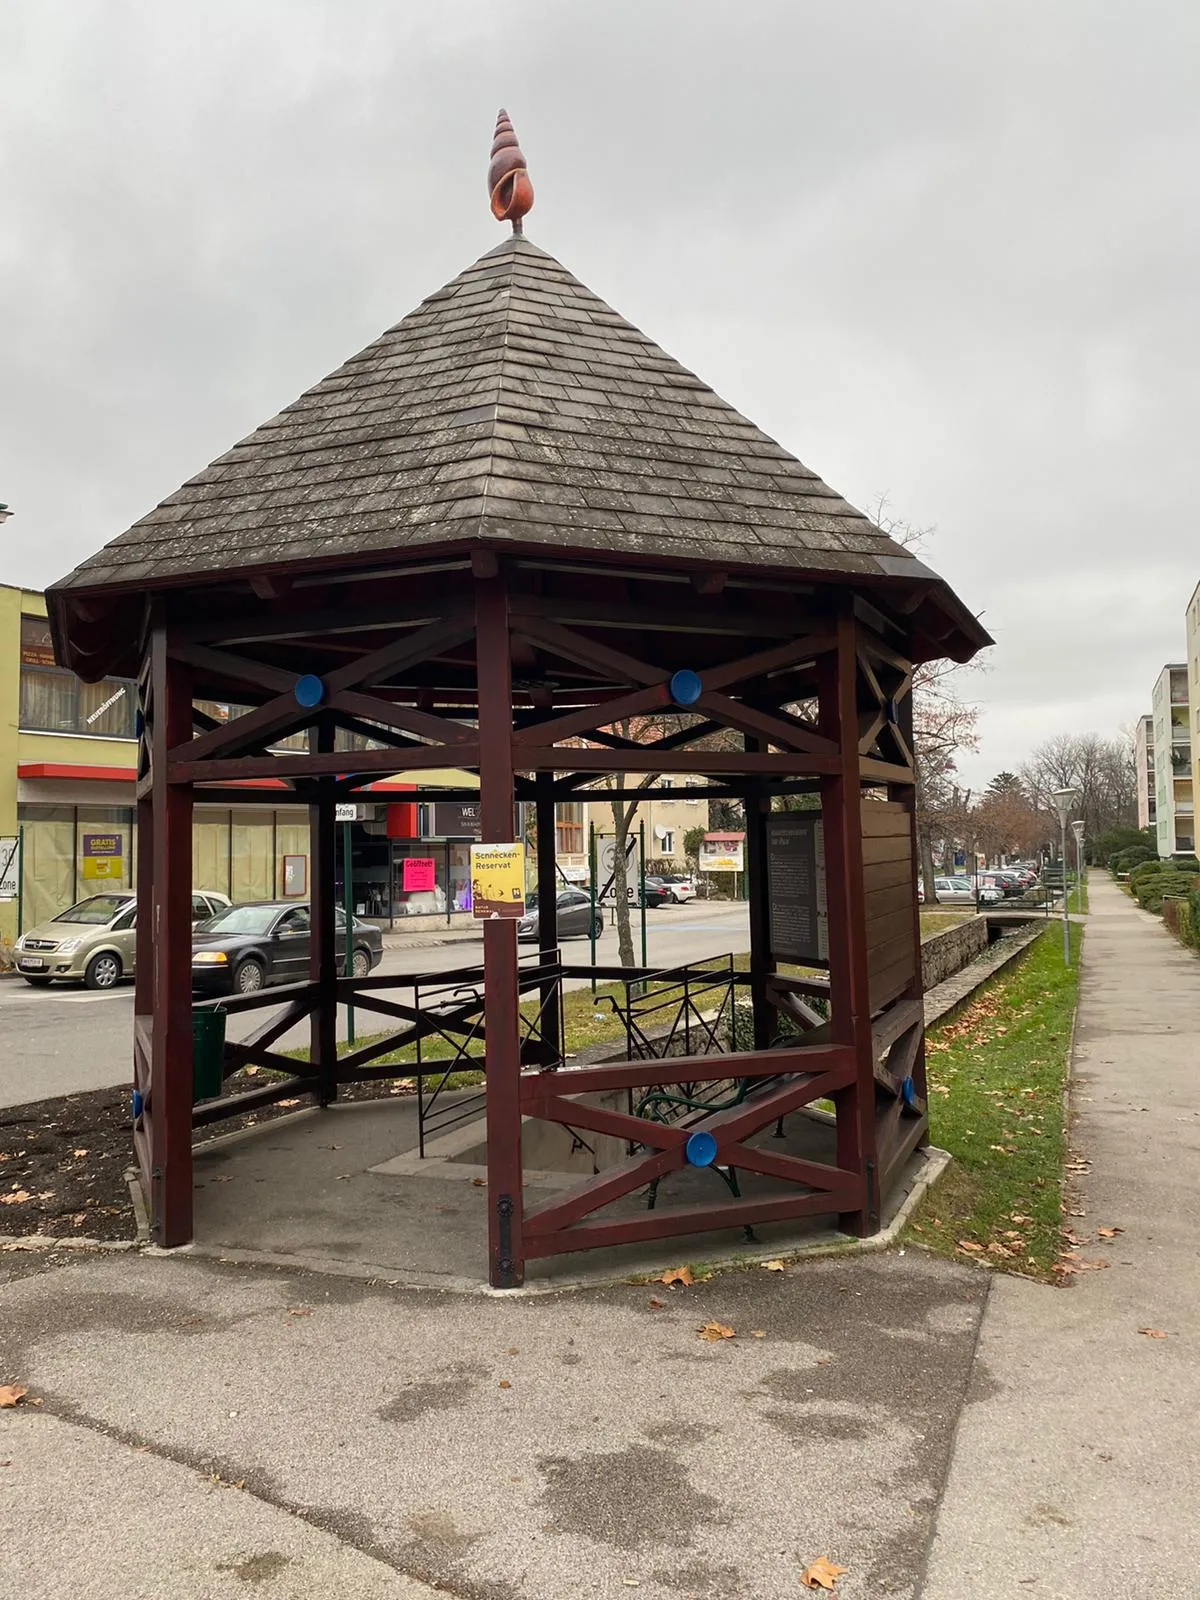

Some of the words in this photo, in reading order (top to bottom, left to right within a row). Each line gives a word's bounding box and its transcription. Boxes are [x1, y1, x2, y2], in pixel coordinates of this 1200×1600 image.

[335, 808, 354, 817] nfang
[90, 838, 116, 846] GRATIS
[475, 852, 521, 860] Schnecken-
[475, 862, 511, 870] Reservat
[0, 880, 16, 890] one
[602, 884, 634, 899] Zoe
